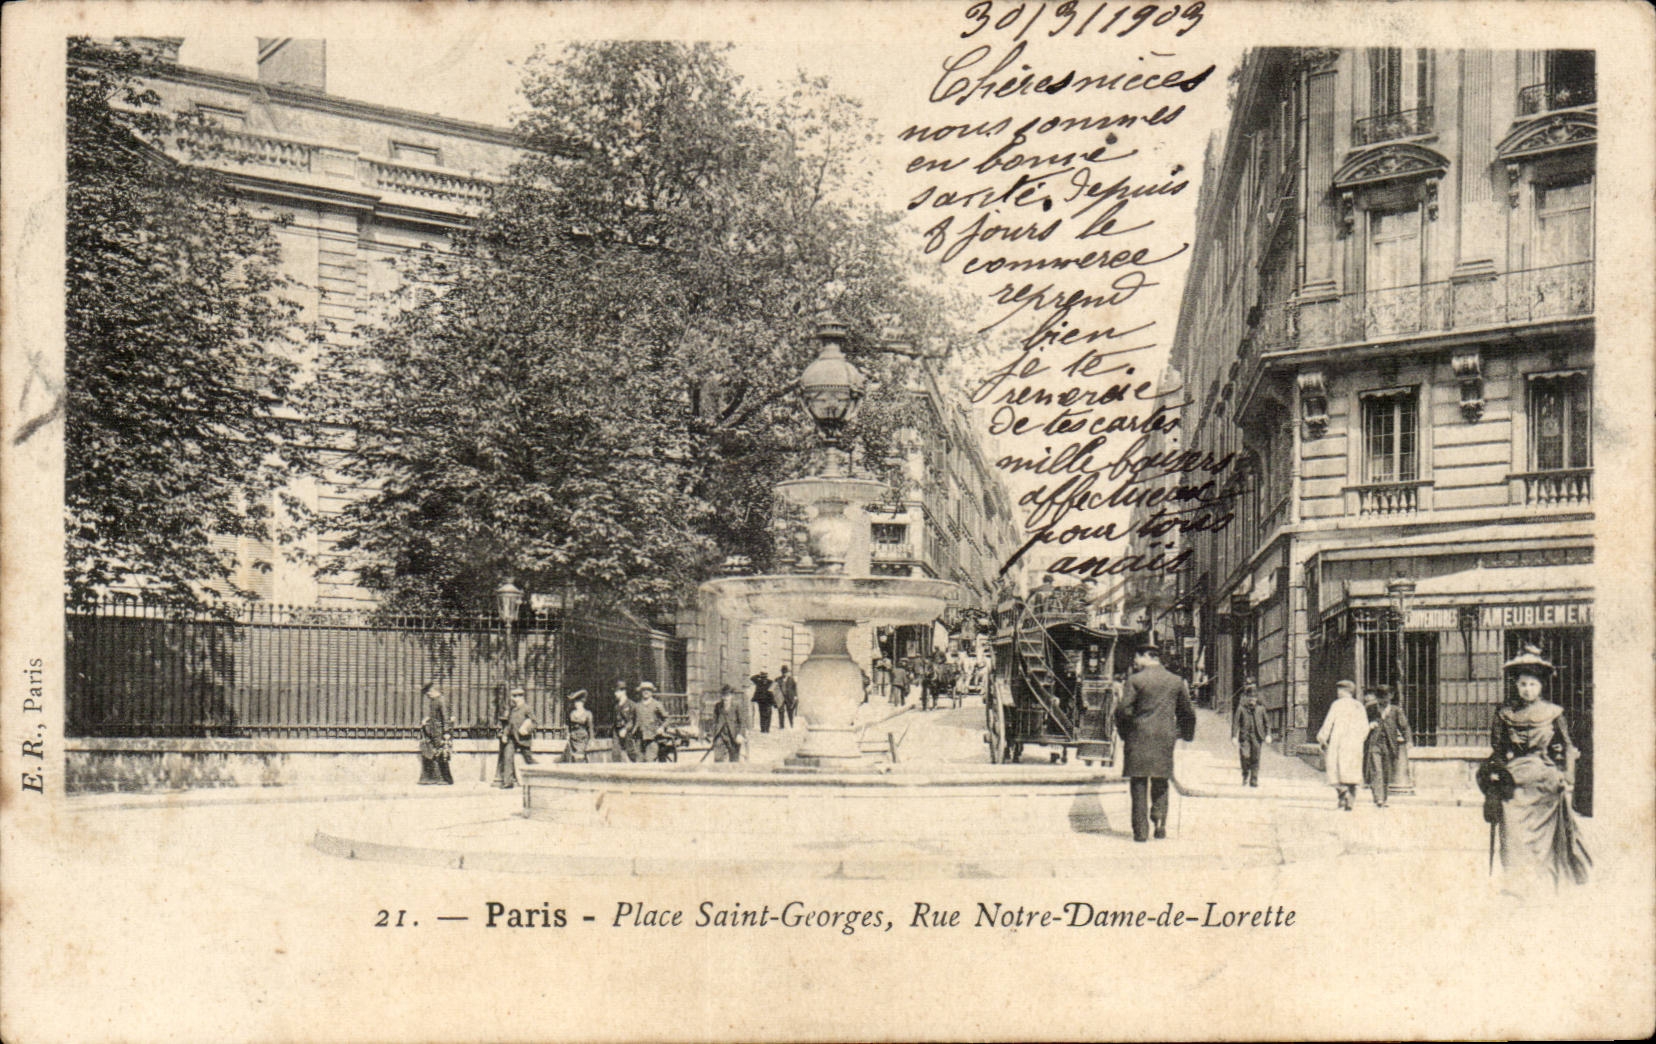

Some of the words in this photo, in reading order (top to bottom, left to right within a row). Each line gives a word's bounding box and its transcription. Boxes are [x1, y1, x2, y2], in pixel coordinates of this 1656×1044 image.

[960, 0, 1204, 42] 30/3/1903
[928, 40, 1076, 105] Chères
[898, 116, 1012, 142] nous
[905, 155, 970, 174] en
[942, 209, 1062, 263] jours
[1074, 199, 1155, 239] le
[963, 242, 1190, 274] commerce
[977, 270, 1161, 333] reprend
[1022, 306, 1157, 351] bien
[995, 435, 1107, 476] mille
[999, 519, 1140, 576] pour
